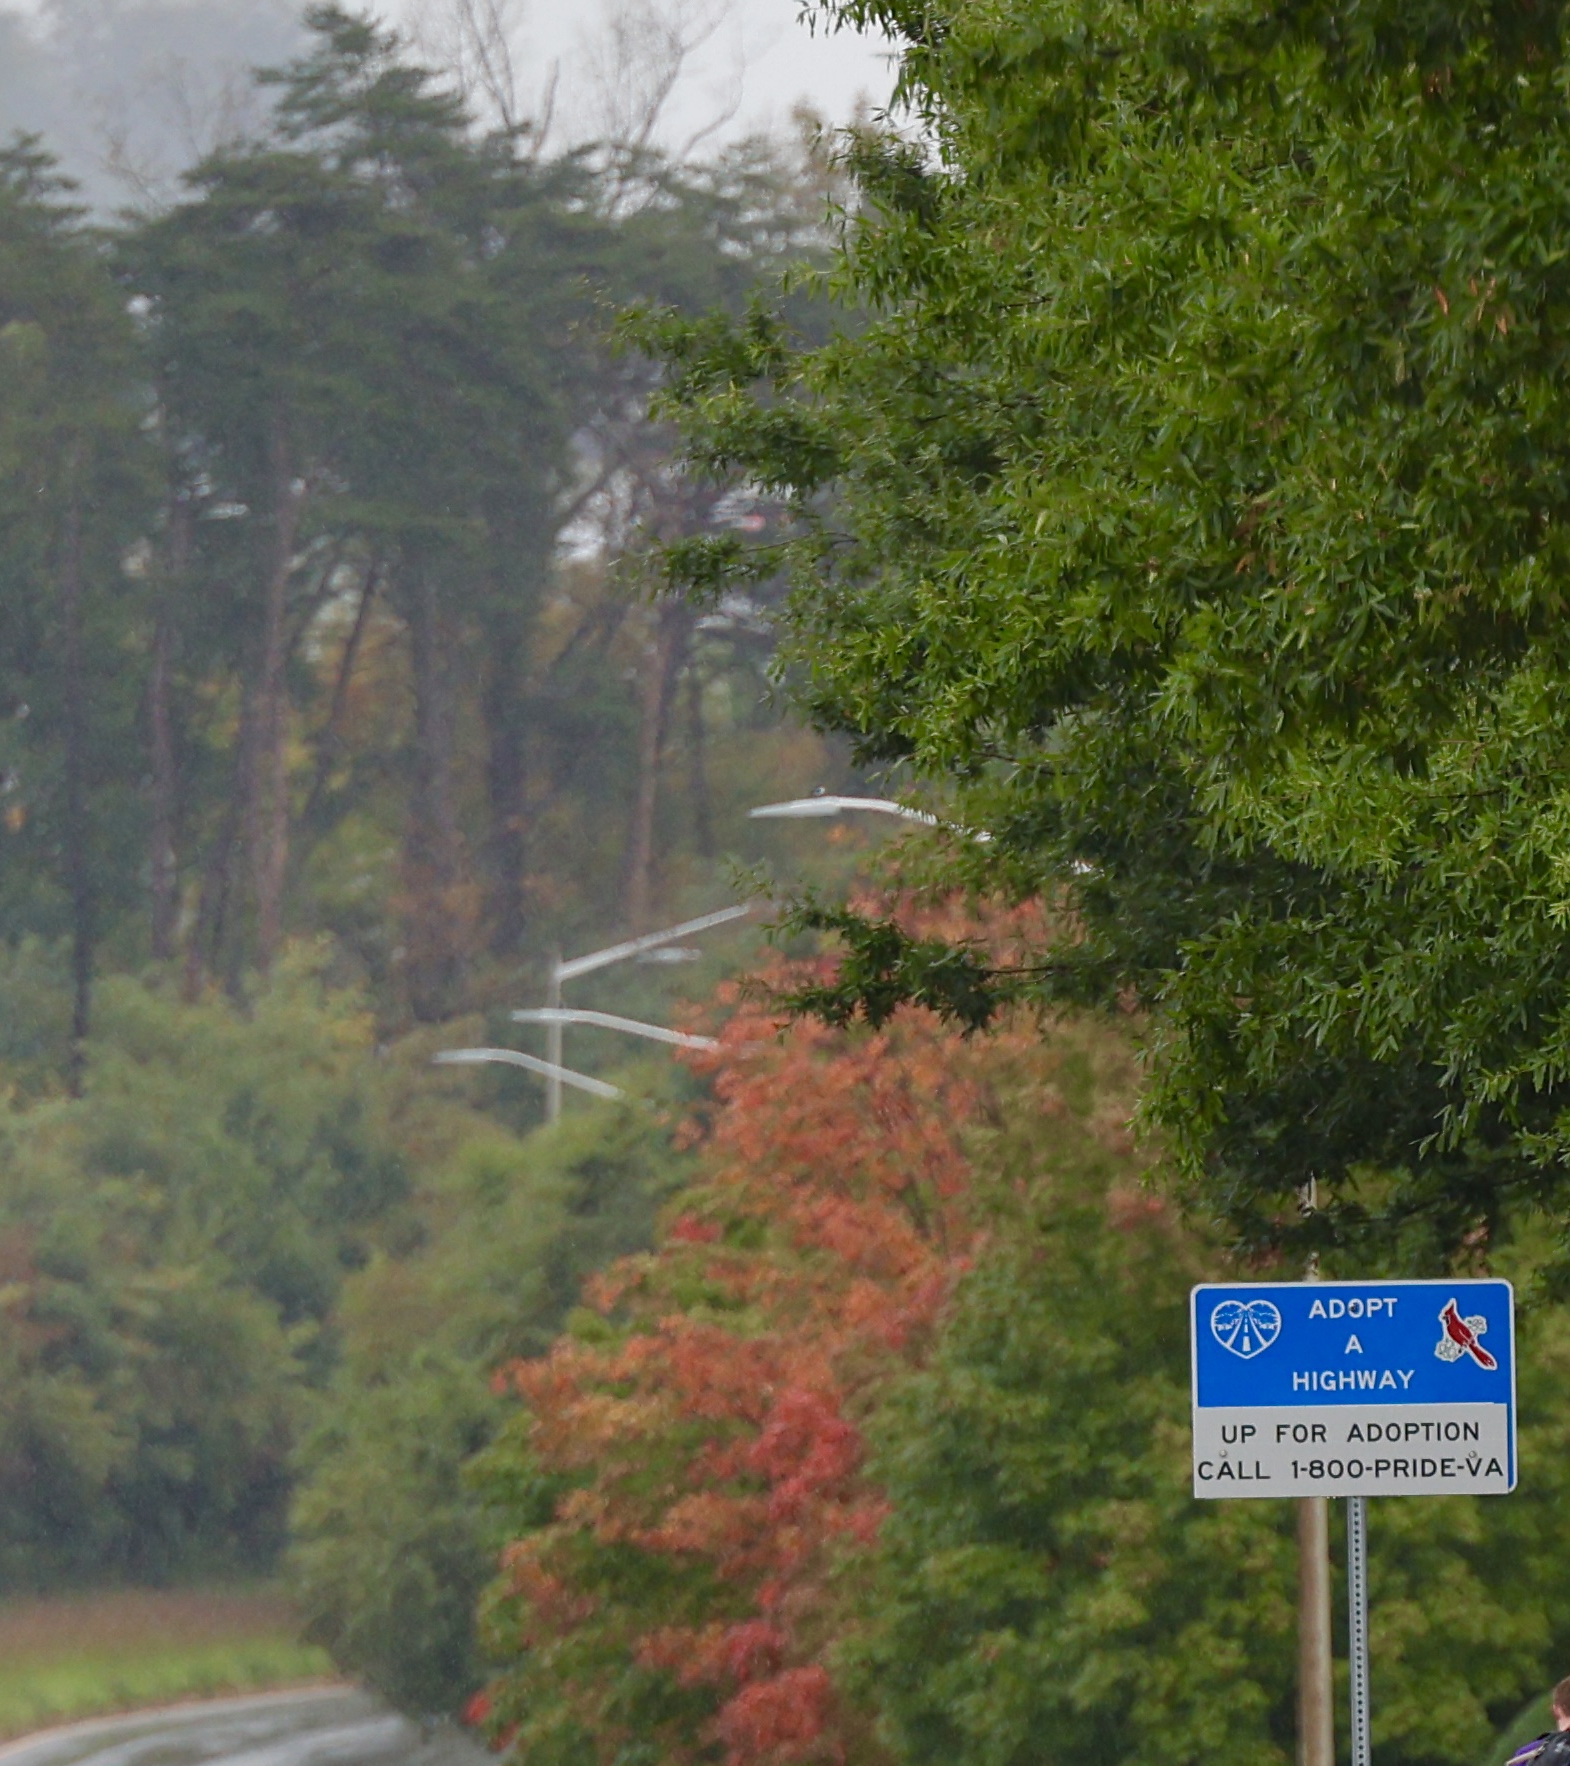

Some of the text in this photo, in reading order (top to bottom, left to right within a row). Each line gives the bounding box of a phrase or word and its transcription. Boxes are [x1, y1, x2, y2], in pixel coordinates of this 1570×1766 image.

[1308, 1298, 1398, 1319] ADOPT
[1344, 1334, 1364, 1354] A
[1292, 1369, 1416, 1391] HIGHWAY
[1221, 1422, 1480, 1444] UP FOR ADOPTION
[1198, 1458, 1504, 1481] CALL 1-800-PRIDE-VA
